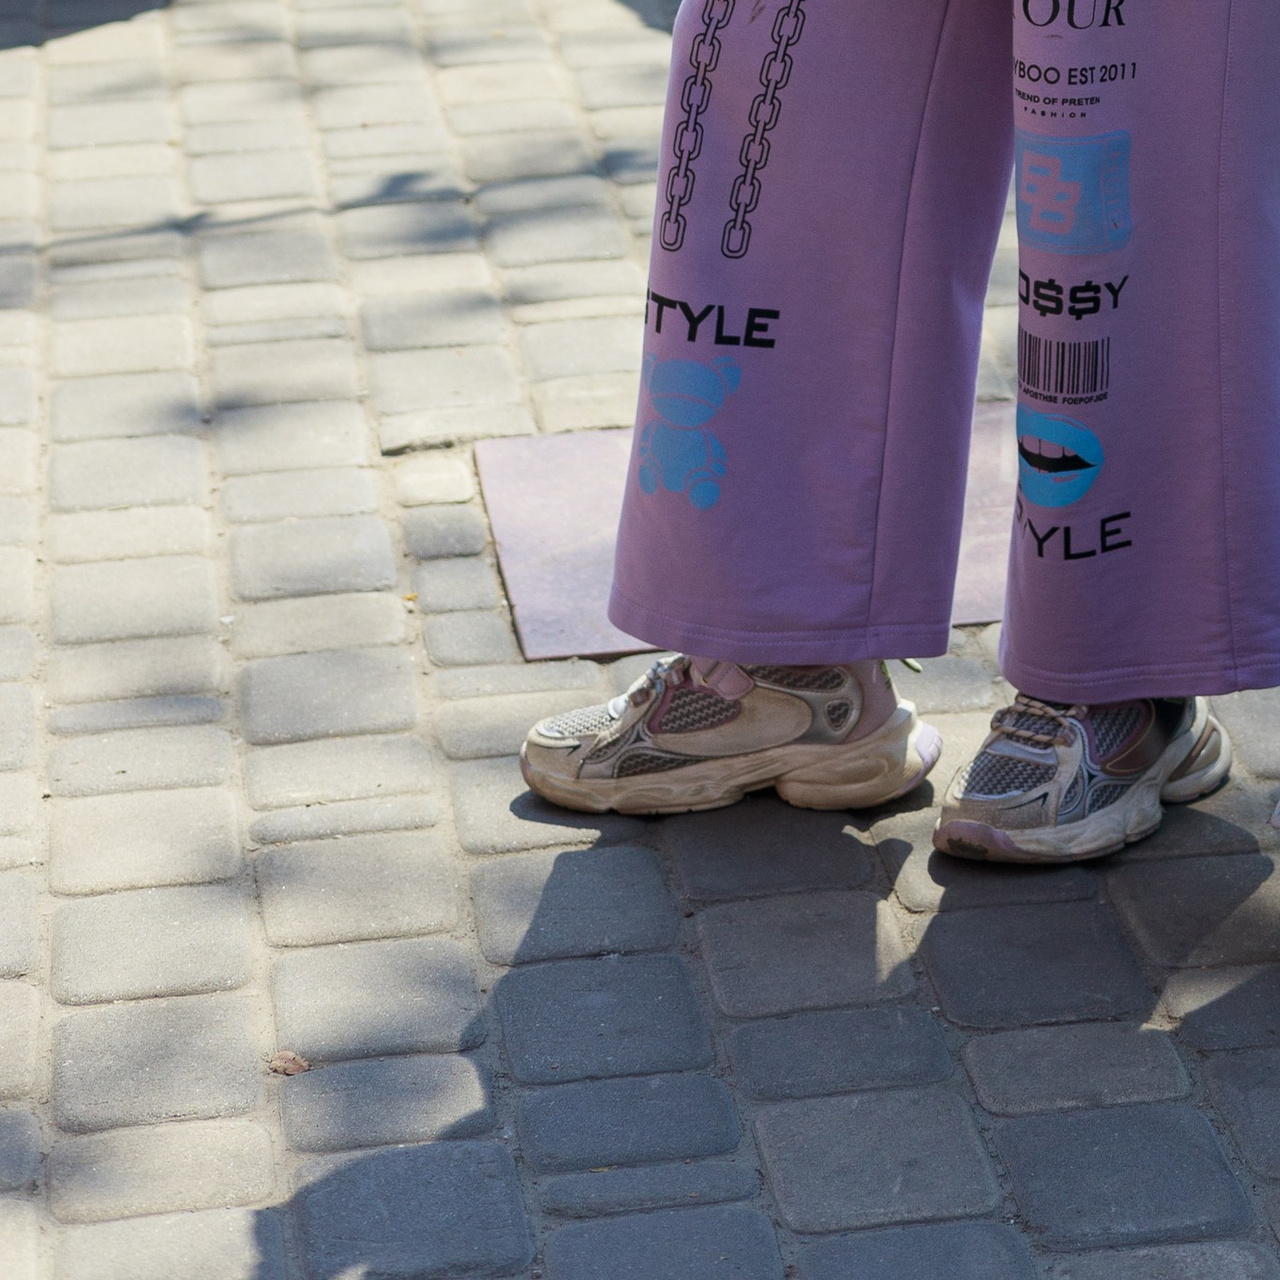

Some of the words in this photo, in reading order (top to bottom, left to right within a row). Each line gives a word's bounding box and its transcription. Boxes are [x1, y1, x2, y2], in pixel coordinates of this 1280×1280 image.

[1068, 66, 1096, 86] EST
[1100, 62, 1137, 83] 2011
[1042, 96, 1059, 107] OF
[1023, 105, 1087, 119] FASHION
[644, 288, 781, 349] TYLE
